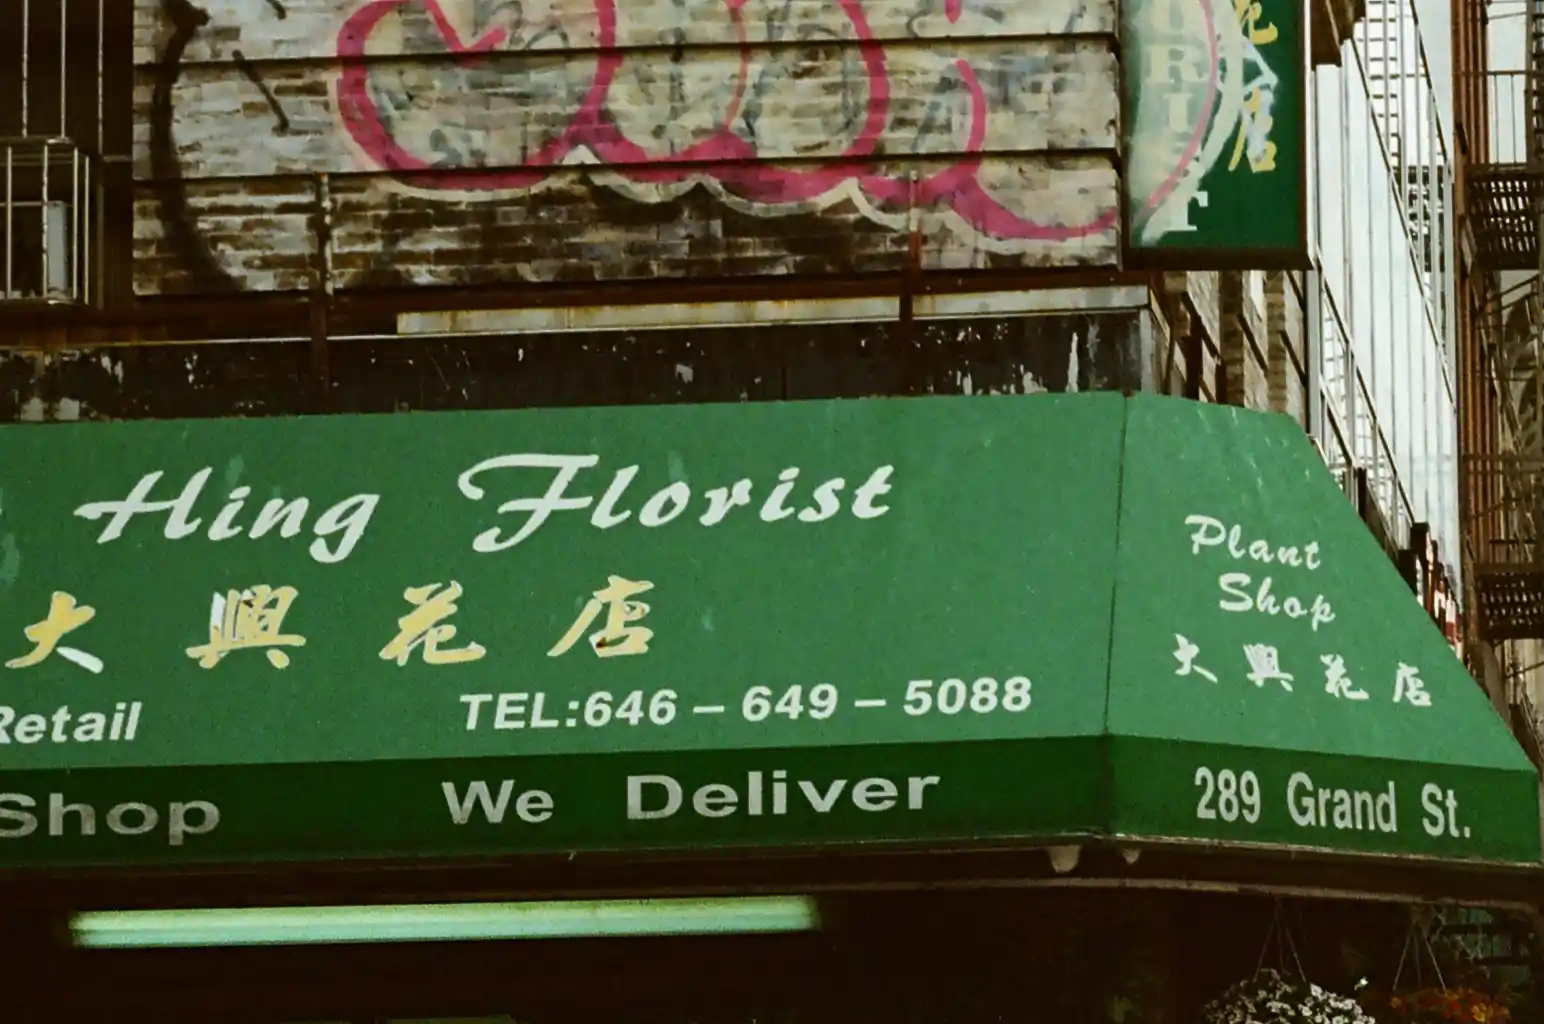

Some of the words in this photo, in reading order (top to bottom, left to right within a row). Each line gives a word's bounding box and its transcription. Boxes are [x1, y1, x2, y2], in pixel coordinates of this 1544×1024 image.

[74, 466, 380, 563] Hing
[458, 453, 894, 553] Florist
[1185, 514, 1321, 570] Plant
[1219, 572, 1336, 632] Shop
[0, 792, 220, 846] Shop
[442, 778, 555, 826] We
[626, 769, 941, 821] Deliver
[1194, 766, 1261, 824] 289
[1287, 771, 1398, 833] Grand
[1421, 782, 1471, 838] St.
